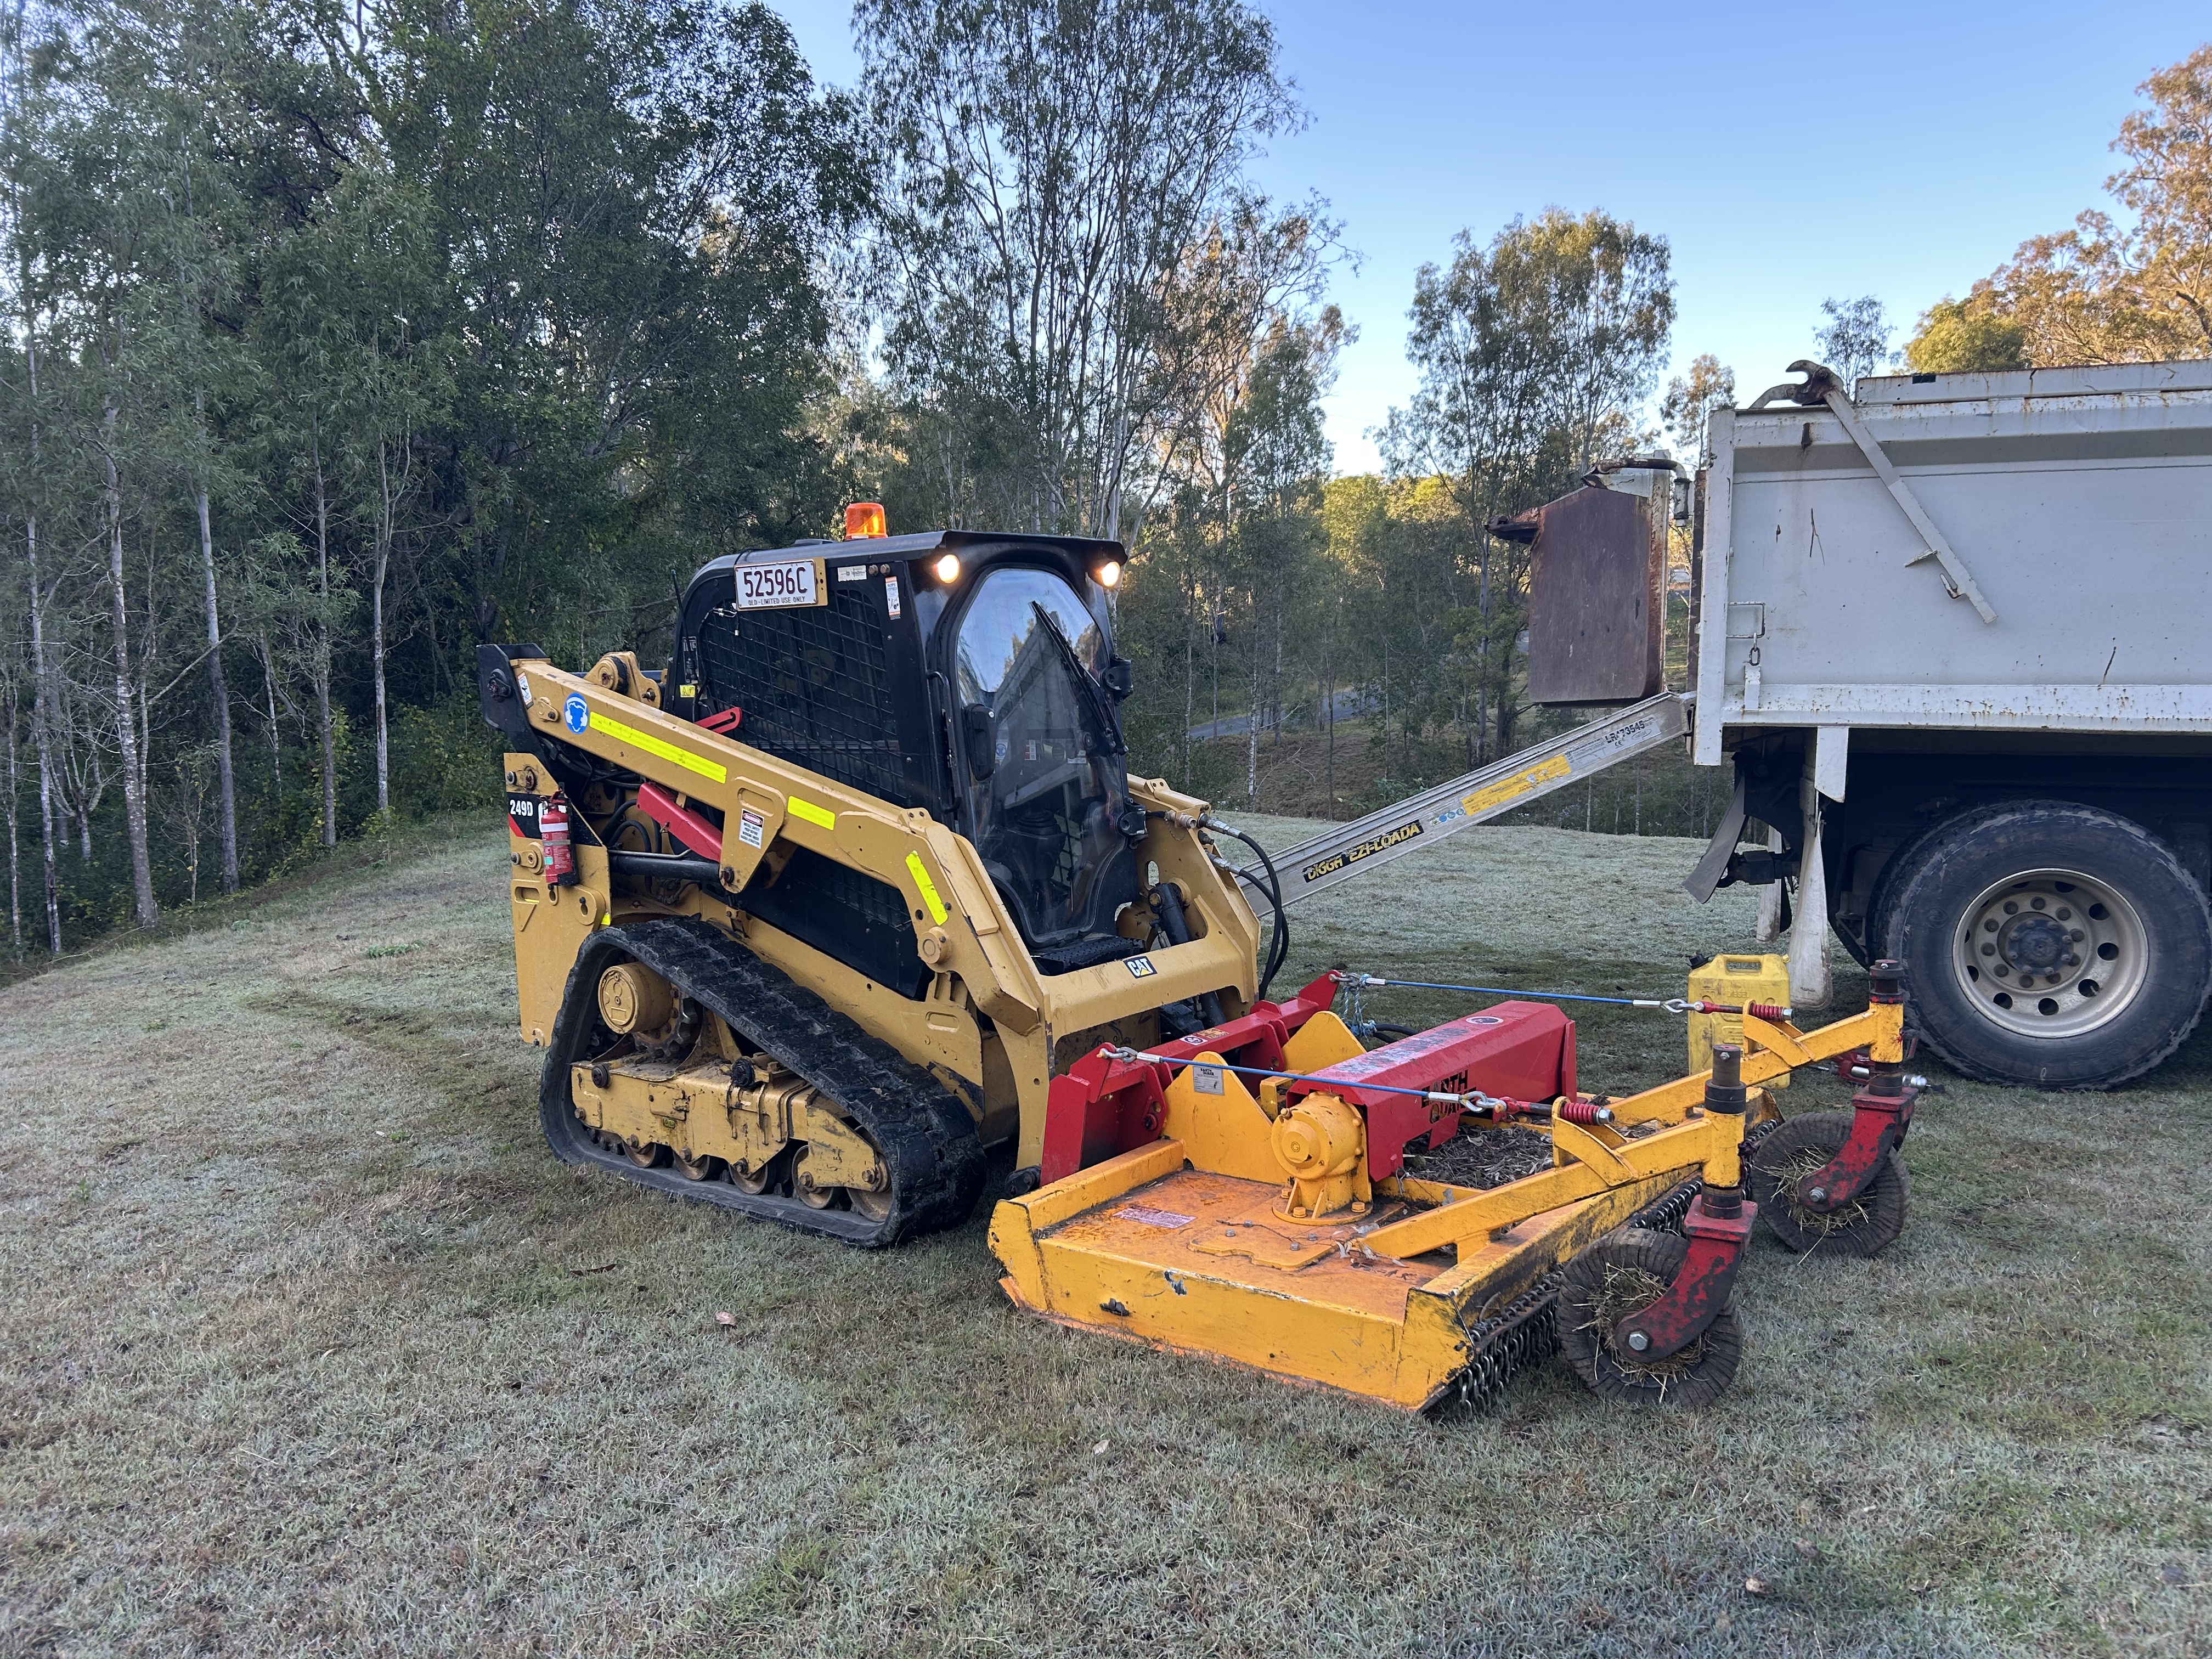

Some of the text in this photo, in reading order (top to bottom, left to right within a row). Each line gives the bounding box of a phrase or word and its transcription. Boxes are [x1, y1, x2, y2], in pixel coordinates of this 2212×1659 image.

[743, 567, 808, 597] 52596C
[510, 799, 533, 816] 249D
[1127, 958, 1154, 977] CAT
